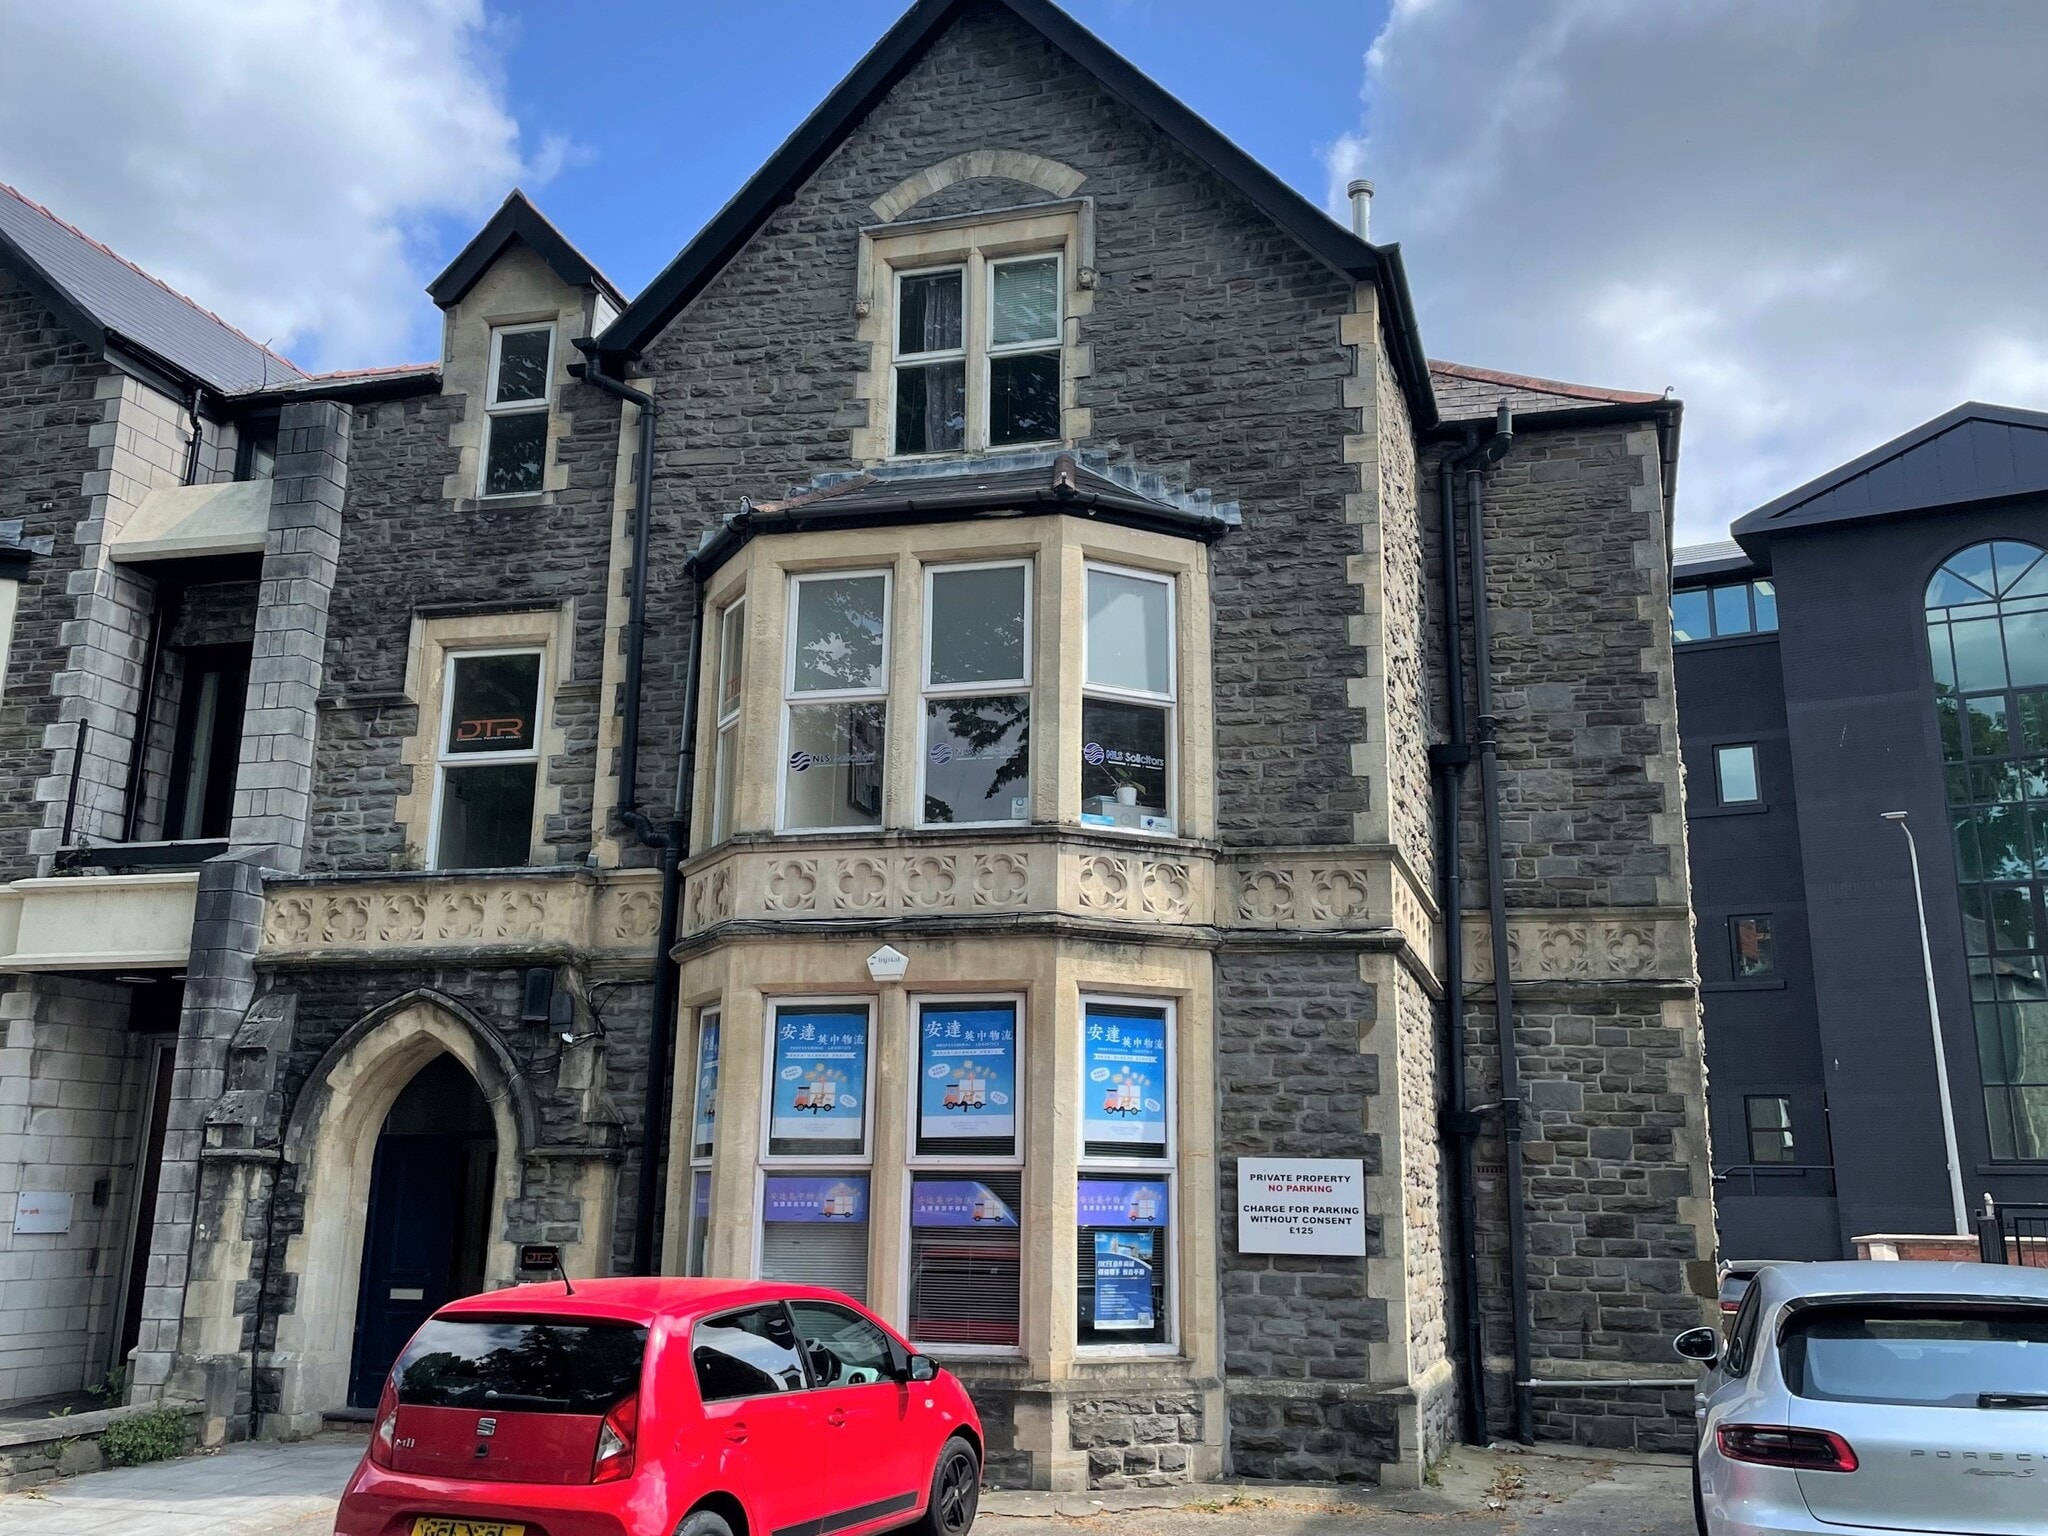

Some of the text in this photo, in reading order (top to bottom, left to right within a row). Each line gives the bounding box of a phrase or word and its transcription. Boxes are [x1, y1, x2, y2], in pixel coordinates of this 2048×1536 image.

[457, 718, 523, 738] DTR
[812, 754, 831, 763] NLS
[1105, 750, 1123, 761] NLS
[1125, 752, 1164, 767] Solicitors
[1249, 1174, 1351, 1183] PRIVATE PROPERTY
[1287, 1185, 1333, 1193] PARKING
[1243, 1205, 1286, 1213] CHARGE
[1313, 1206, 1359, 1215] PARKING
[1250, 1215, 1352, 1225] WITHOUT CONSENT
[1290, 1227, 1313, 1235] £125
[526, 1252, 553, 1262] DTR
